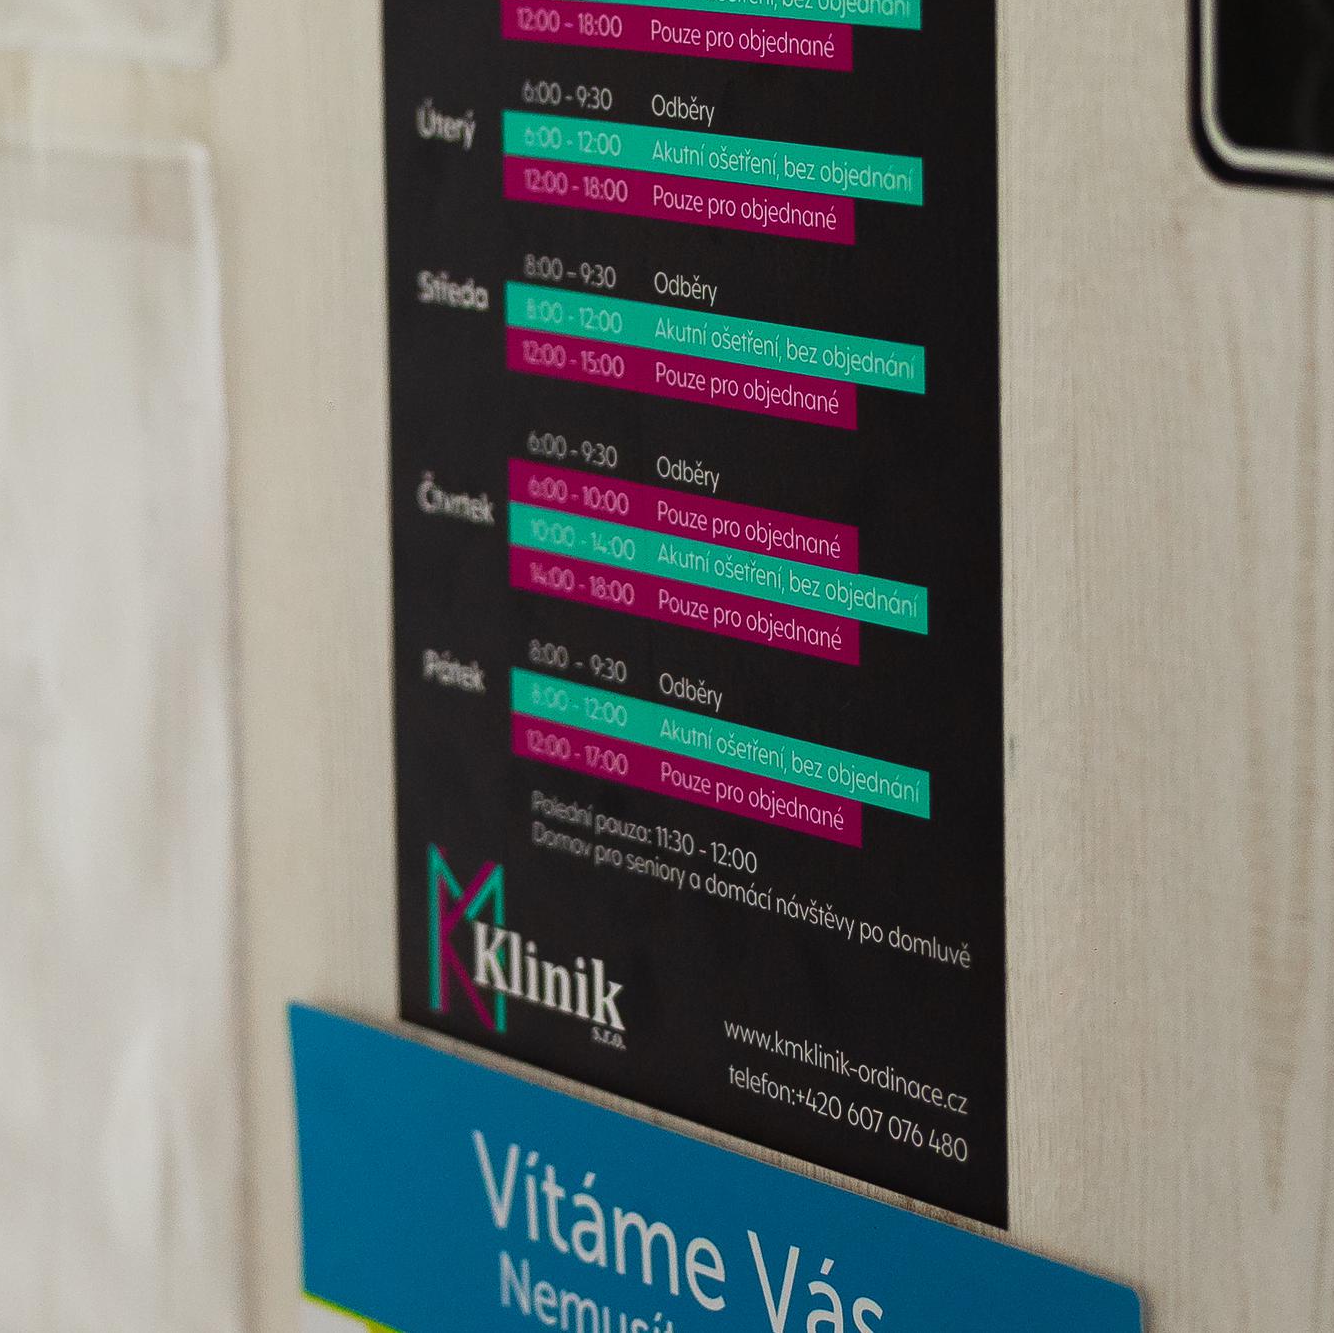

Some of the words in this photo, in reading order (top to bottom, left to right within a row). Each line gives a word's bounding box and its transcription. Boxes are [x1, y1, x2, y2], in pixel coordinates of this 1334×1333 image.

[517, 6, 560, 32] 12:00
[578, 13, 622, 38] 18:00
[651, 19, 701, 46] Pouze
[706, 29, 734, 51] pro
[739, 28, 835, 58] objednané
[417, 97, 476, 149] Úterý
[523, 79, 561, 106] 6:00
[576, 85, 612, 110] 9:30
[651, 94, 715, 127] Odběry
[524, 126, 562, 150] 6:00
[578, 130, 622, 156] 12:00
[652, 139, 705, 166] Akutní
[708, 145, 780, 181] ošetření,
[784, 155, 816, 181] bez
[820, 161, 913, 192] objednání
[523, 168, 568, 195] 12:00
[582, 176, 628, 203] 18:00
[653, 184, 703, 212] Pouze
[708, 197, 736, 219] pro
[741, 198, 837, 230] objednané
[523, 253, 563, 281] 8:00
[580, 262, 616, 288] 9:30
[654, 271, 717, 306] Odběry
[527, 298, 563, 323] 8:00
[579, 307, 623, 334] 12:00
[654, 317, 708, 346] Akutní
[711, 325, 783, 363] ošetření,
[786, 337, 818, 364] bez
[822, 346, 916, 380] objednání
[522, 340, 566, 367] 12:00
[580, 350, 625, 378] 15:00
[655, 361, 706, 391] Pouze
[711, 376, 739, 398] pro
[743, 378, 839, 415] objednané
[527, 430, 567, 459] 6:00
[581, 440, 617, 467] 9:30
[656, 455, 720, 493] Odběry
[582, 486, 629, 515] 10:00
[657, 500, 707, 531] Pouze
[712, 516, 740, 538] pro
[745, 520, 841, 559] objednané
[530, 519, 575, 548] 10:00
[590, 531, 635, 561] 14:00
[658, 542, 710, 573] Akutní
[714, 554, 786, 595] ošetření,
[789, 569, 820, 598] bez
[825, 579, 918, 617] objednání
[589, 575, 635, 605] 18:00
[658, 588, 708, 621] Pouze
[713, 605, 741, 628] pro
[746, 610, 842, 651] objednané
[589, 654, 627, 683] 9:30
[659, 672, 722, 713] Odběry
[583, 697, 628, 727] 12:00
[659, 718, 713, 750] Akutní
[716, 731, 788, 775] ošetření,
[791, 750, 823, 779] bez
[827, 764, 921, 803] objednání
[584, 745, 629, 776] 17:00
[660, 761, 711, 795] Pouze
[715, 781, 744, 803] pro
[748, 788, 844, 831] objednané
[530, 790, 593, 828] Polední
[594, 813, 652, 844] pauza:
[654, 825, 695, 856] 11:30
[709, 841, 758, 874] 12:00
[531, 820, 592, 858] Domov
[594, 844, 623, 867] pro
[625, 852, 686, 890] seniory
[689, 871, 701, 890] a
[705, 872, 773, 911] domácí
[775, 893, 856, 940] návštěvy
[859, 921, 884, 944] po
[888, 925, 972, 969] domluvě
[470, 920, 626, 1031] Klinik
[723, 1019, 968, 1115] www.kmklinik-ordinace.cz
[728, 1064, 842, 1120] telefon:+420
[847, 1102, 883, 1133] 607
[888, 1115, 923, 1147] 076
[928, 1128, 968, 1162] 480
[471, 1129, 727, 1312] Vítáme
